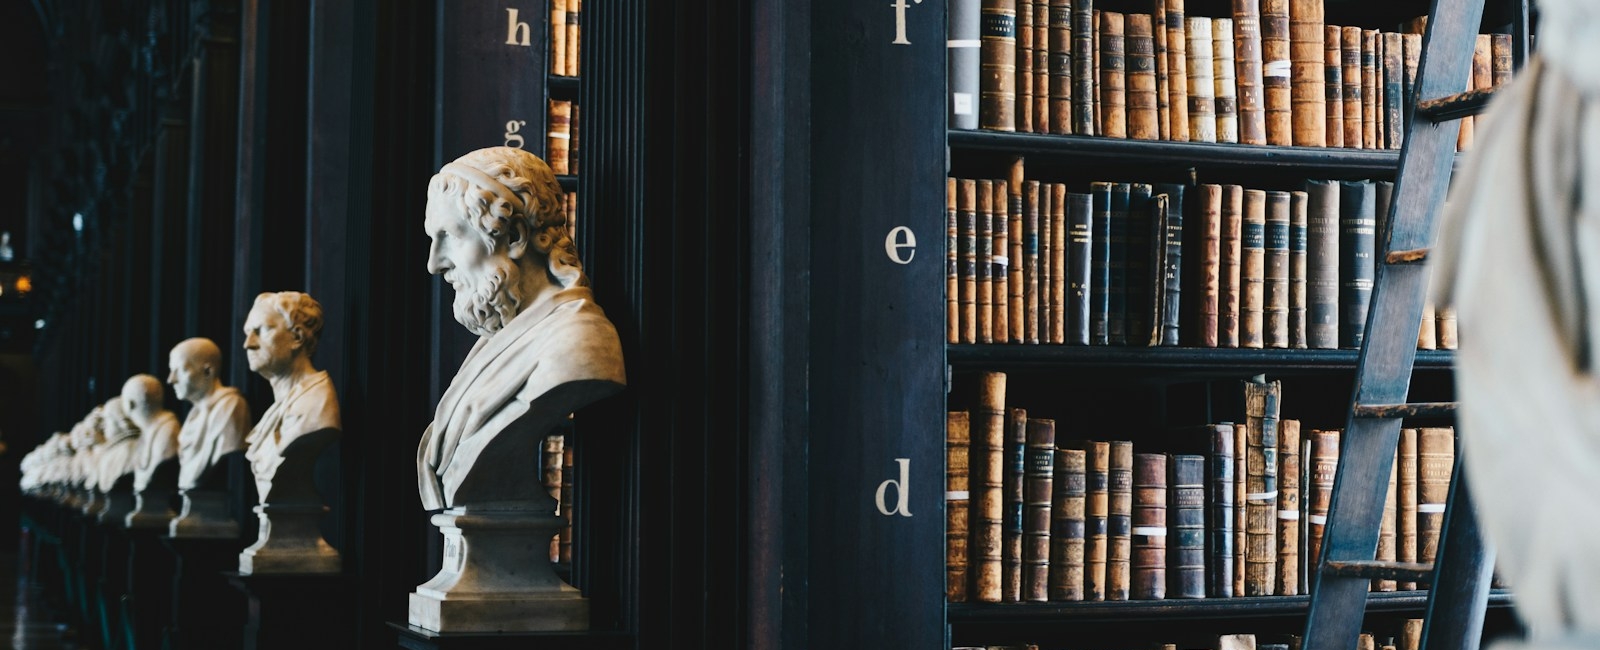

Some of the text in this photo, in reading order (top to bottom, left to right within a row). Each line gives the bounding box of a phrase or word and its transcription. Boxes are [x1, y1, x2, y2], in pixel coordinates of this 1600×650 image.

[505, 8, 531, 46] h
[504, 119, 527, 149] g
[885, 226, 917, 265] e
[875, 458, 913, 517] d
